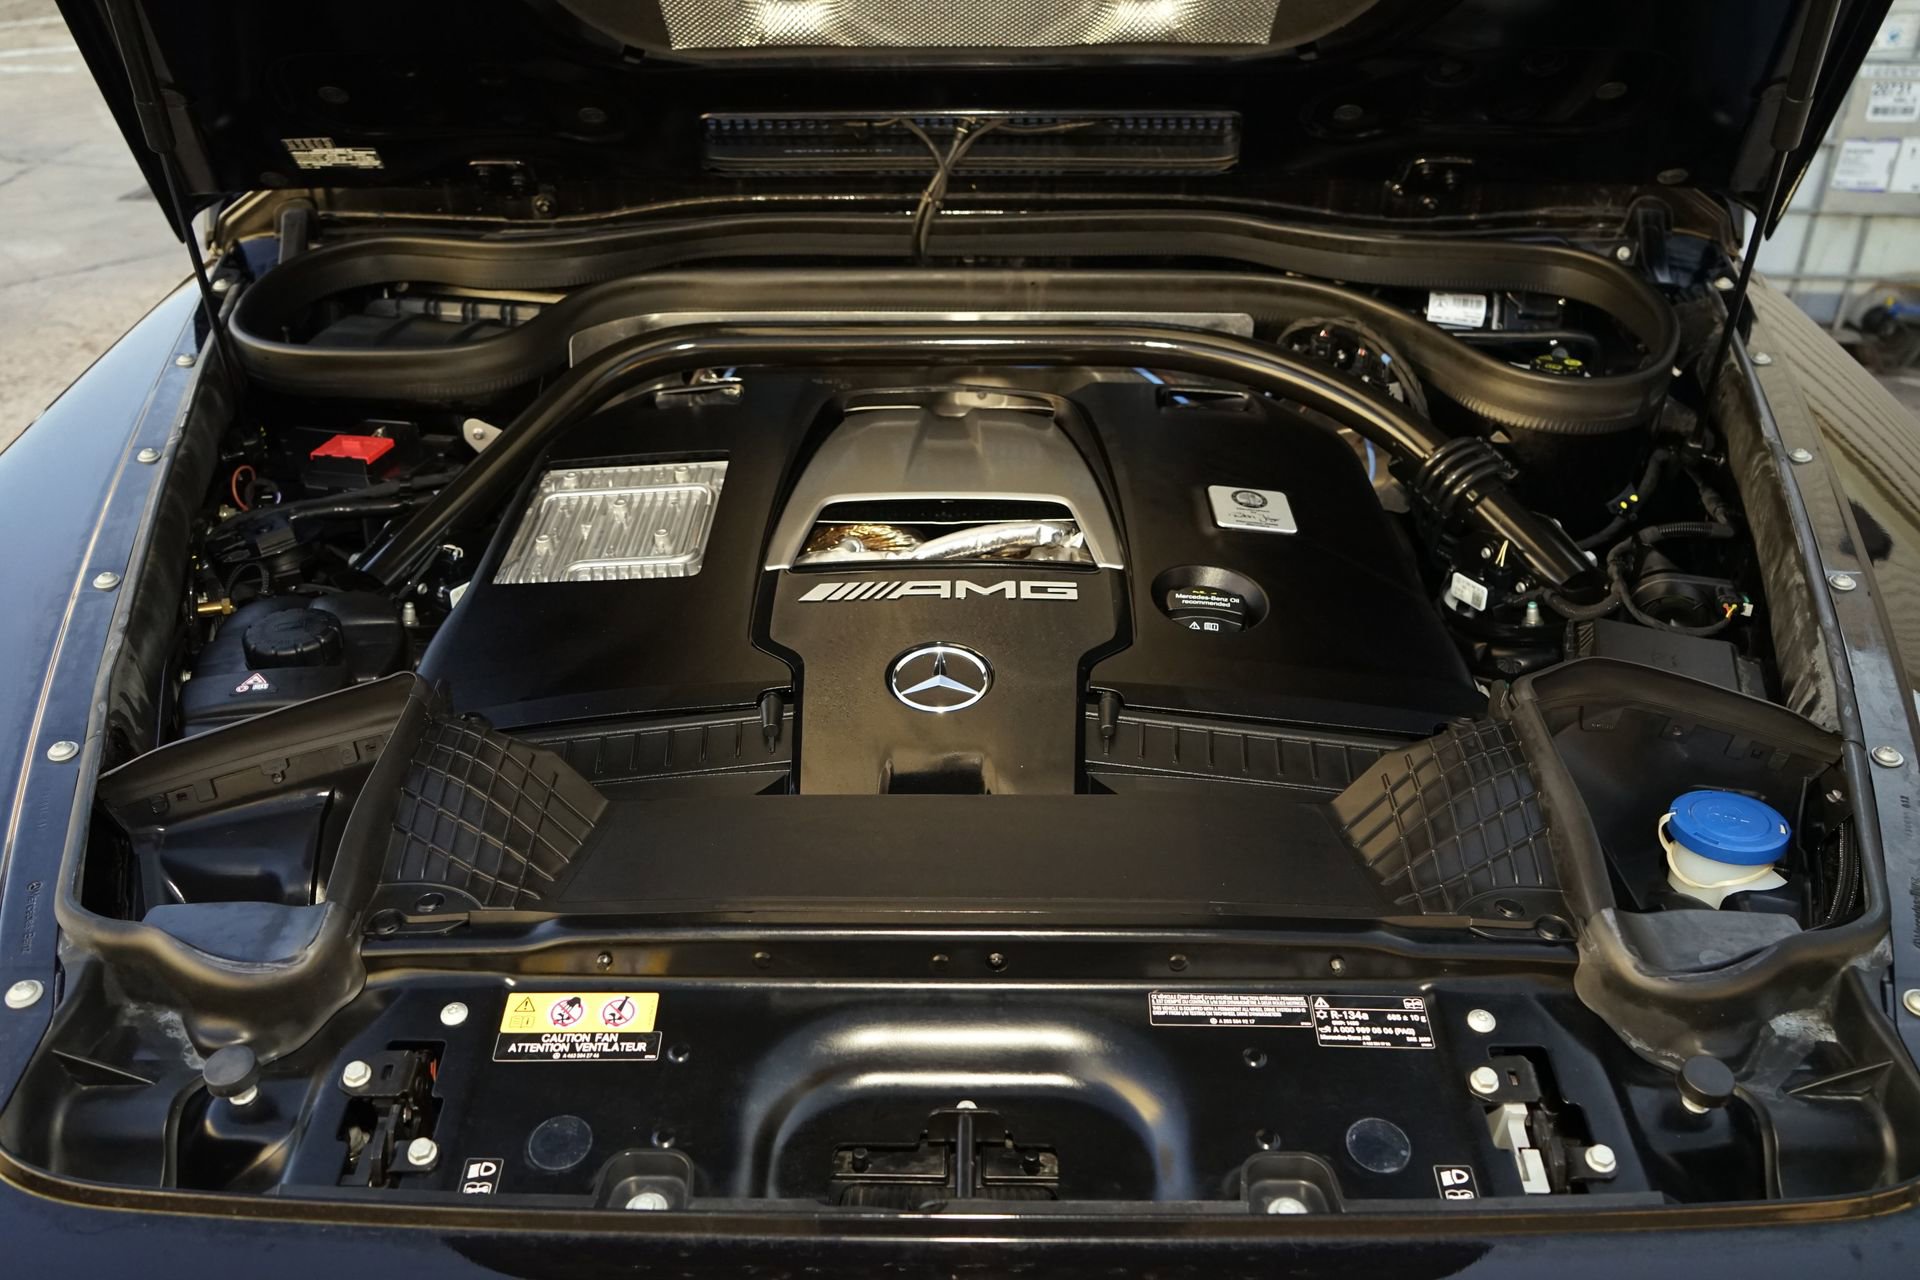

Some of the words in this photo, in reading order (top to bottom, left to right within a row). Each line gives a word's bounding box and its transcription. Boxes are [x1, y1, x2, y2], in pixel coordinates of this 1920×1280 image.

[887, 580, 1079, 599] AMG
[1175, 593, 1228, 603] Mercedes-Benz
[1182, 598, 1231, 608] recommended
[1330, 1010, 1369, 1020] R-134a
[541, 1033, 594, 1042] CAUTION
[595, 1033, 619, 1042] FAN
[508, 1043, 570, 1053] ATTENTION
[575, 1042, 647, 1052] VENTILATEUR
